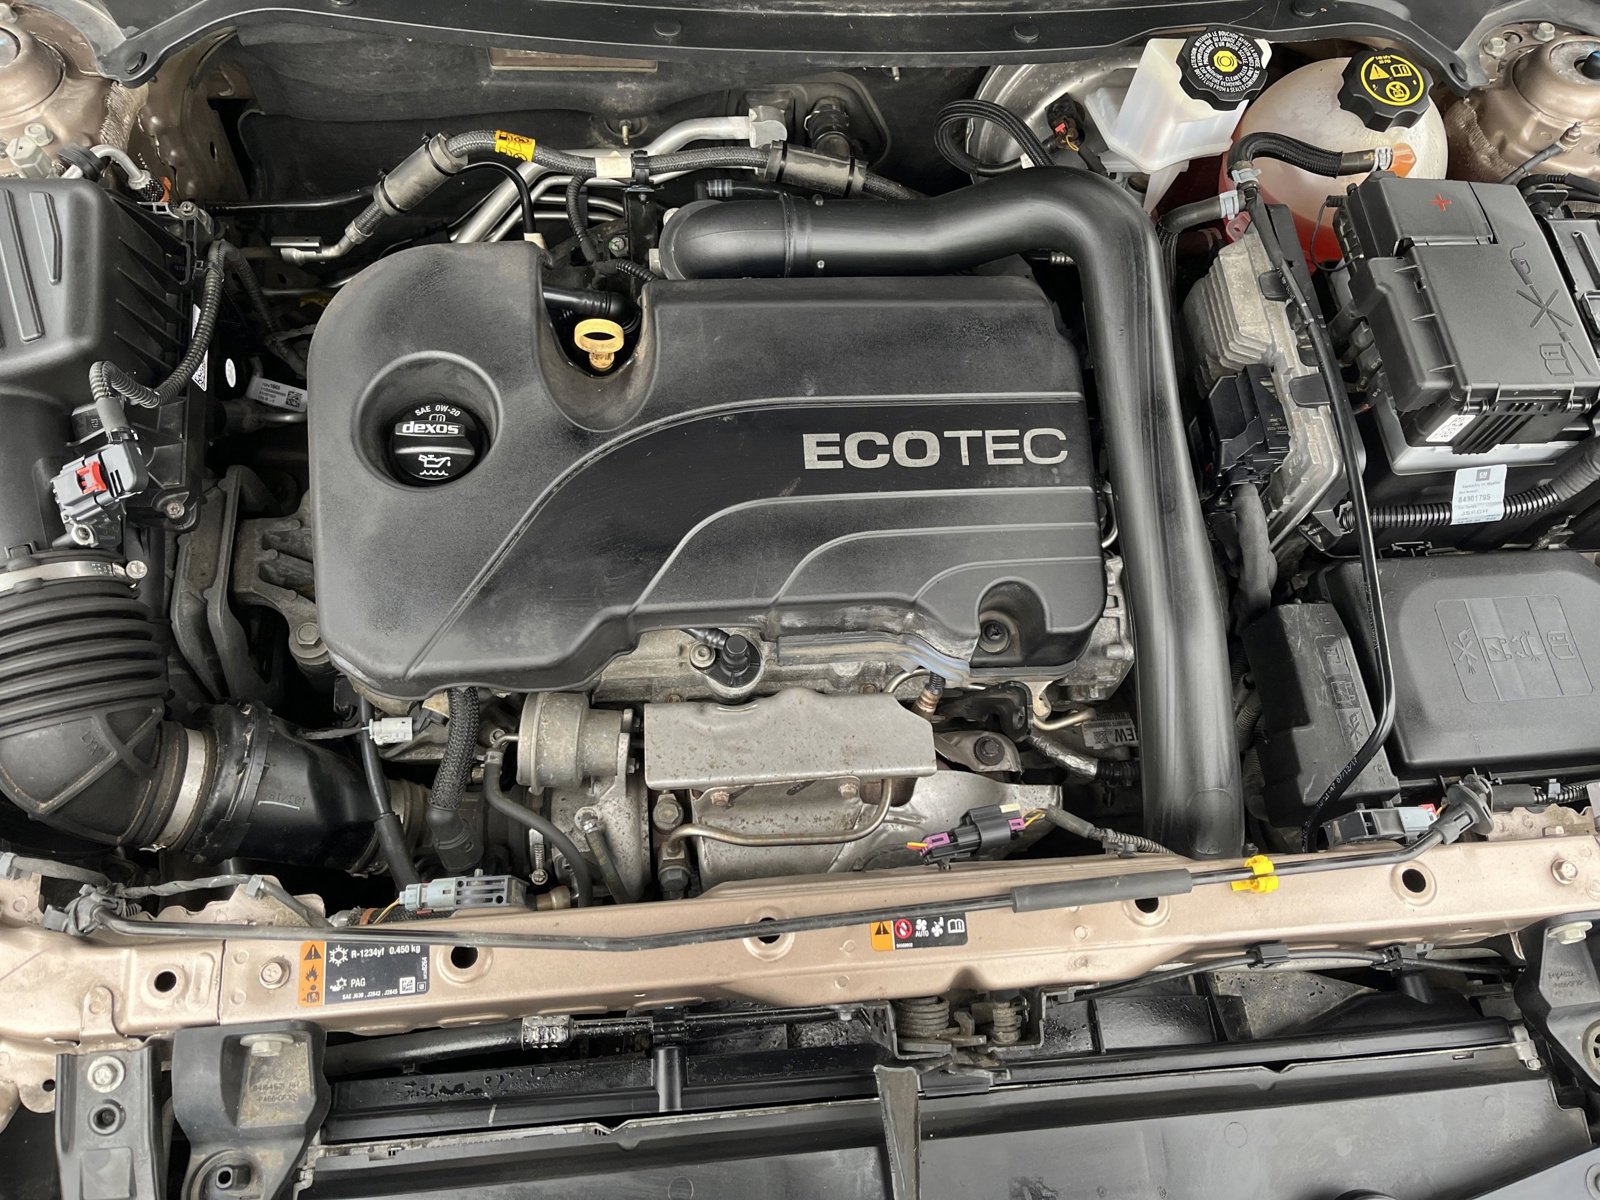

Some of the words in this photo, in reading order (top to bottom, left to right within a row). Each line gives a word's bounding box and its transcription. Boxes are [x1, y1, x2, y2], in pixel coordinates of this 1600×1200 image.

[414, 405, 432, 416] SAE
[435, 404, 461, 417] 0W-20
[402, 421, 459, 434] dexos
[803, 427, 1068, 469] ECOTEC
[1115, 728, 1138, 742] EW
[915, 930, 930, 938] AUTO
[350, 947, 385, 959] R-1234yf
[389, 945, 409, 955] 0.450
[411, 945, 421, 954] kg
[350, 978, 366, 988] PAG
